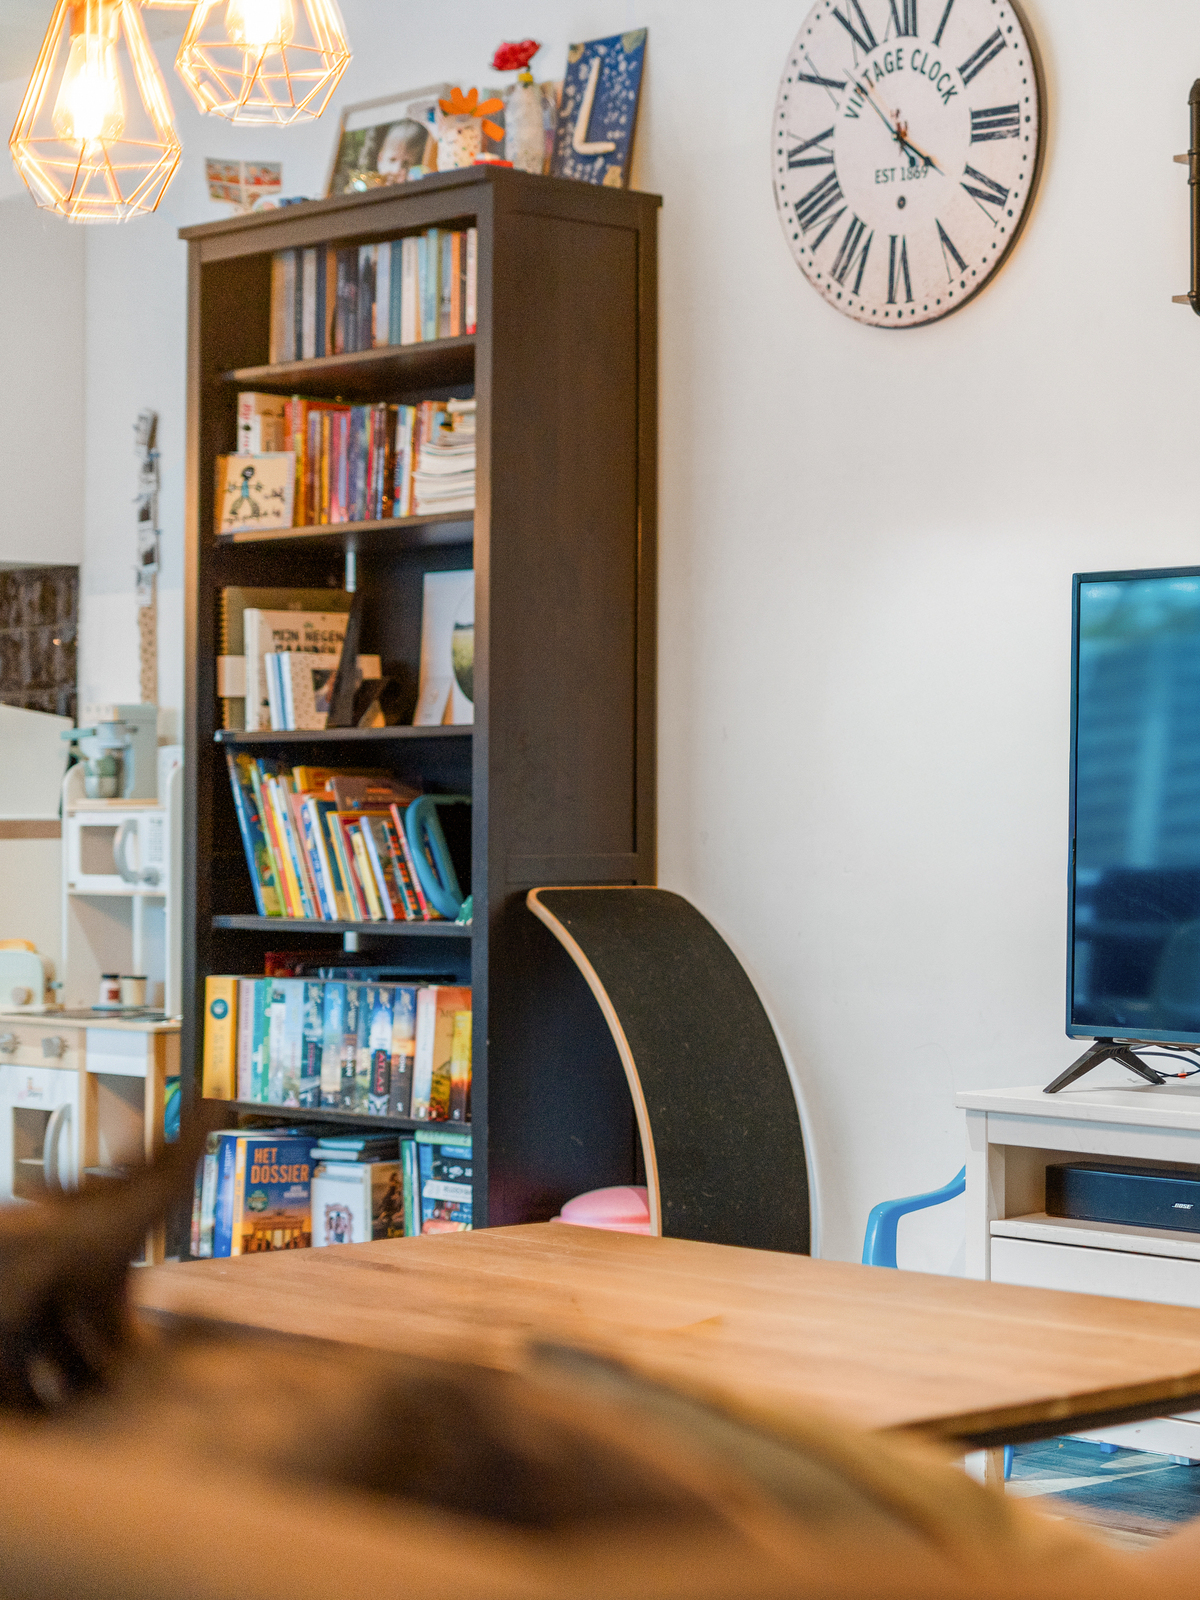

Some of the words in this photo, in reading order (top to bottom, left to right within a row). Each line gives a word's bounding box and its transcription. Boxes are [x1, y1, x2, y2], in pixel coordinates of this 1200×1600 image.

[911, 48, 959, 106] CLOCK
[572, 56, 616, 155] L
[874, 167, 896, 185] EST
[900, 165, 929, 182] 1869
[376, 1052, 386, 1092] ATLAS
[254, 1147, 279, 1165] HET
[250, 1164, 310, 1185] DOSSIER
